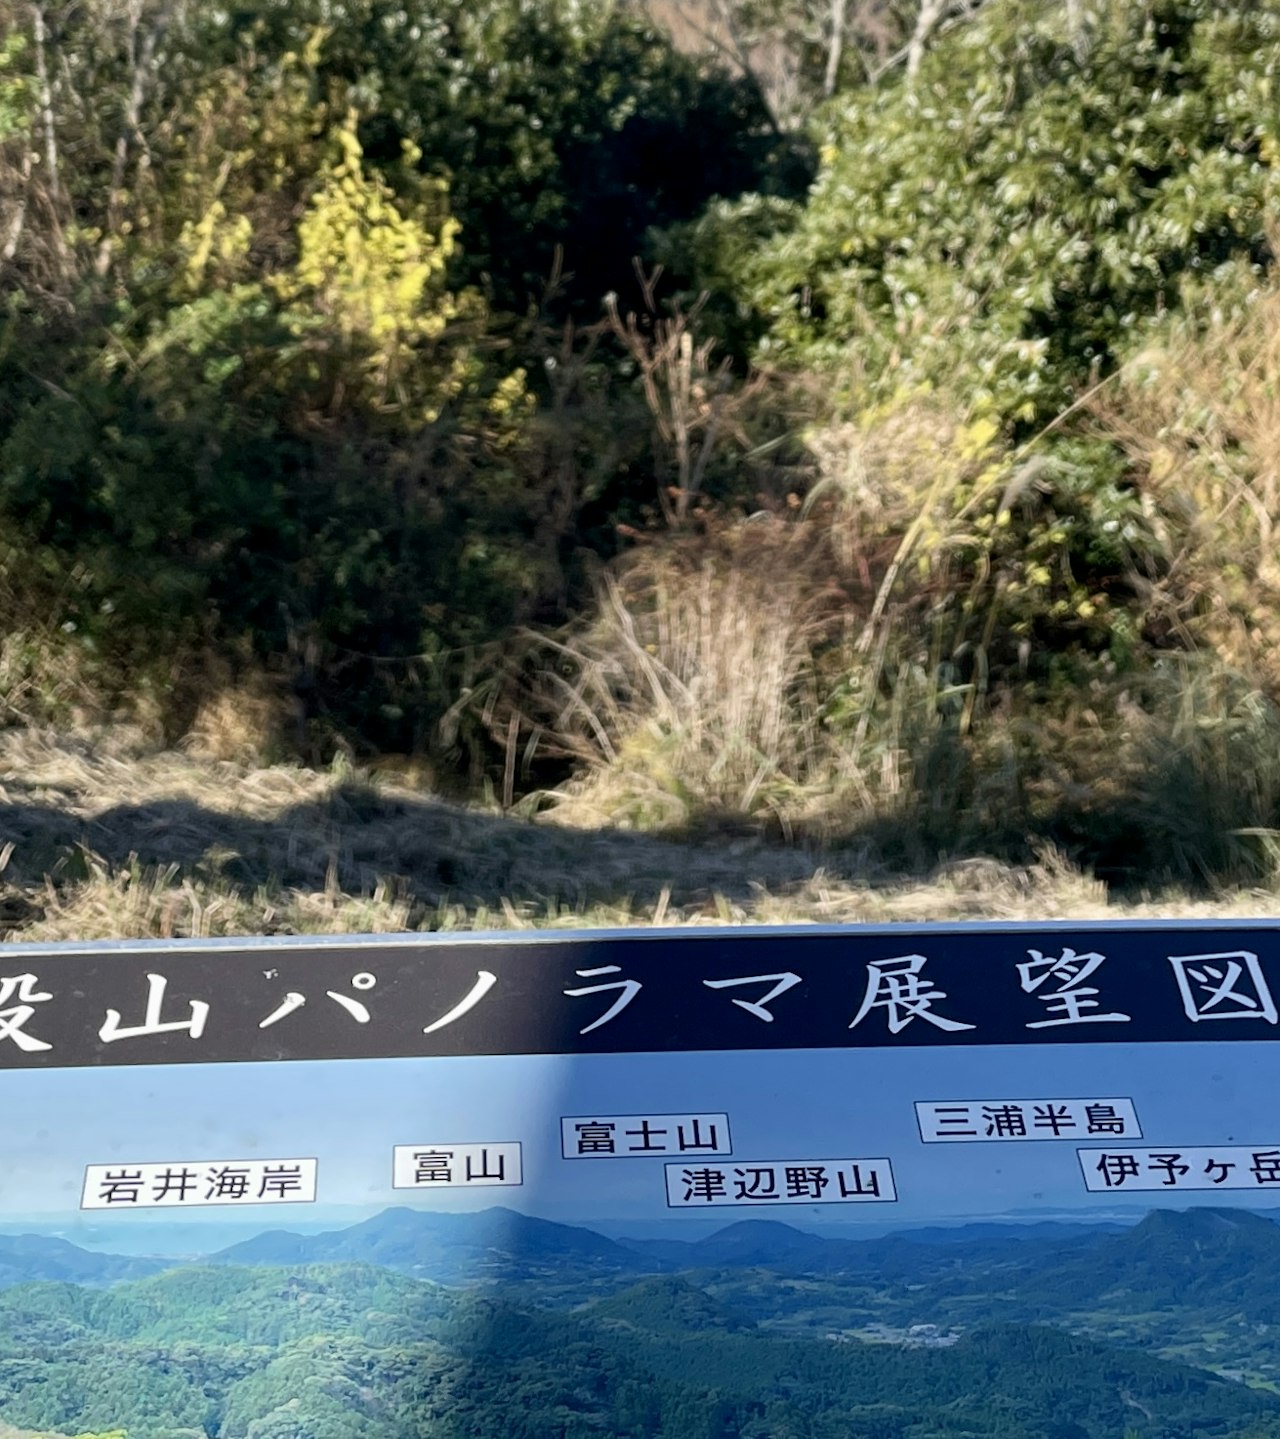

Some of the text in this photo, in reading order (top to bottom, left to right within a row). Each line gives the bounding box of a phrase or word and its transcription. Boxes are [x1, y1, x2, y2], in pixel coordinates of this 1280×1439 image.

[574, 1119, 718, 1153] 富士山
[935, 1103, 1126, 1137] 三浦半島
[98, 1164, 303, 1204] 岩井海岸
[412, 1148, 506, 1184] 富山
[681, 1165, 881, 1201] 津辺野山
